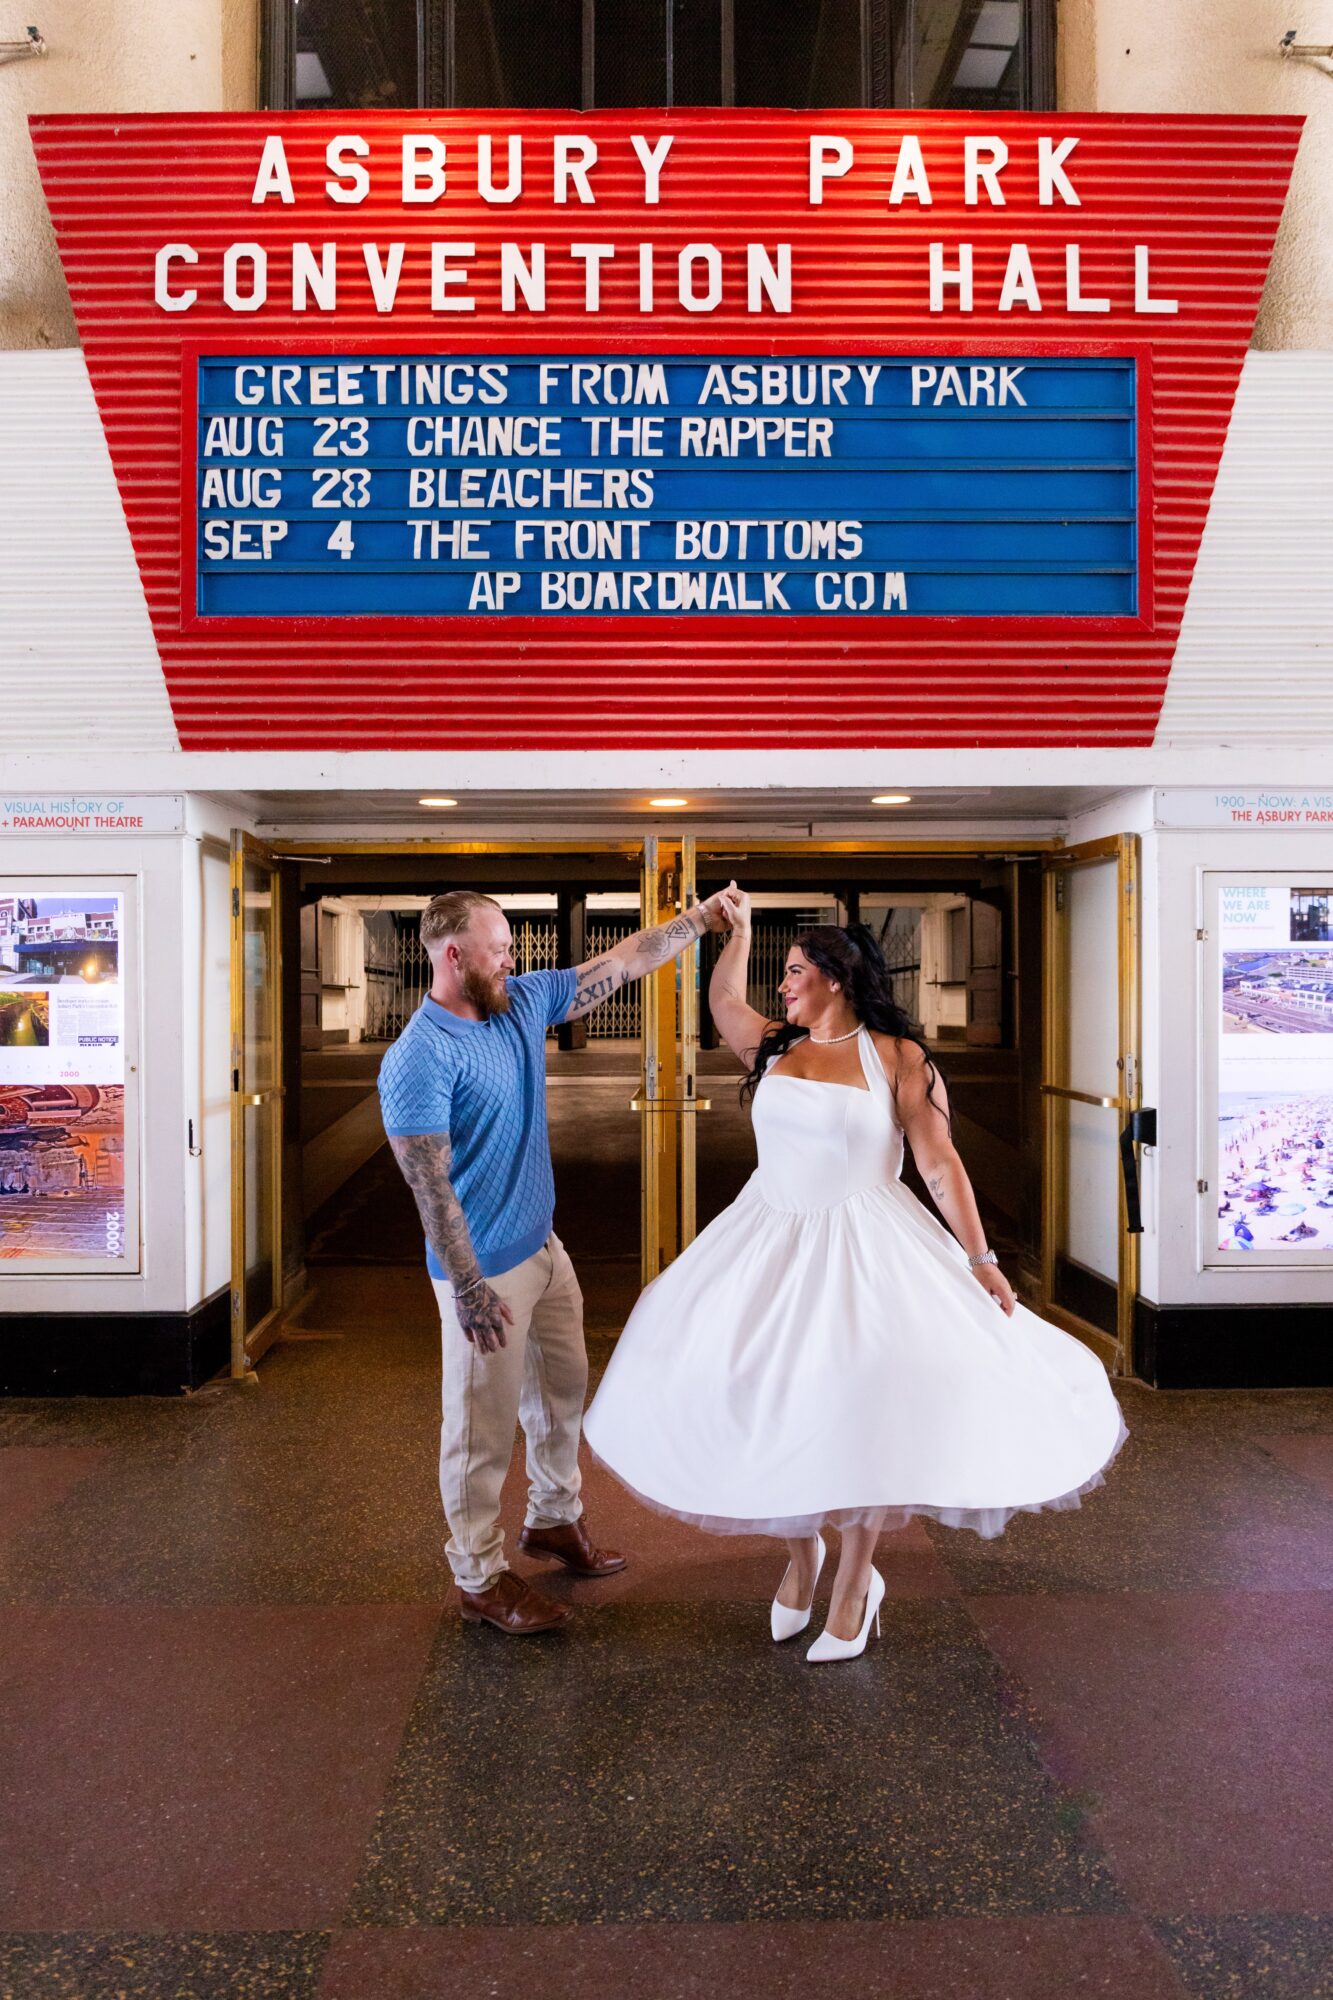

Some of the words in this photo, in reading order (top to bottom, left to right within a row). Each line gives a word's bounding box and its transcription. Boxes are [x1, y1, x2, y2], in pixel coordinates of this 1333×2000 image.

[251, 134, 674, 204] ASBURY
[809, 135, 1081, 206] PARK
[154, 242, 792, 313] CONVENTION
[929, 242, 1179, 313] HALL
[235, 363, 509, 405] GREETINGS
[539, 363, 670, 405] FROM
[698, 364, 882, 406] ASBURY
[911, 365, 1026, 406] PARK
[203, 416, 284, 457] AUG
[313, 416, 369, 457] 23
[407, 415, 562, 457] CHANCE
[581, 416, 665, 457] THE
[680, 416, 834, 457] RAPPER
[202, 467, 282, 508] AUG
[312, 468, 372, 508] 28
[409, 468, 654, 509] BLEACHERS
[204, 519, 288, 560] SEP
[327, 520, 355, 560] 4
[406, 519, 492, 560] THE
[515, 519, 651, 560] FRONT
[675, 520, 863, 560] BOTTOMS
[468, 571, 521, 610] AP
[541, 571, 791, 610] BOARDWALK
[815, 571, 907, 611] COM
[4, 801, 46, 814] VISUAL
[50, 801, 103, 814] HISTORY
[106, 801, 125, 814] OF
[1301, 796, 1310, 808] A
[13, 816, 91, 828] PARAMOUNT
[94, 816, 143, 828] THEATRE
[1231, 810, 1252, 822] THE
[1256, 810, 1302, 822] ASBURY
[1305, 810, 1333, 822] PARK
[1222, 887, 1267, 898] WHERE
[1222, 900, 1243, 911] WE
[1246, 900, 1271, 911] ARE
[1223, 912, 1257, 923] NOW
